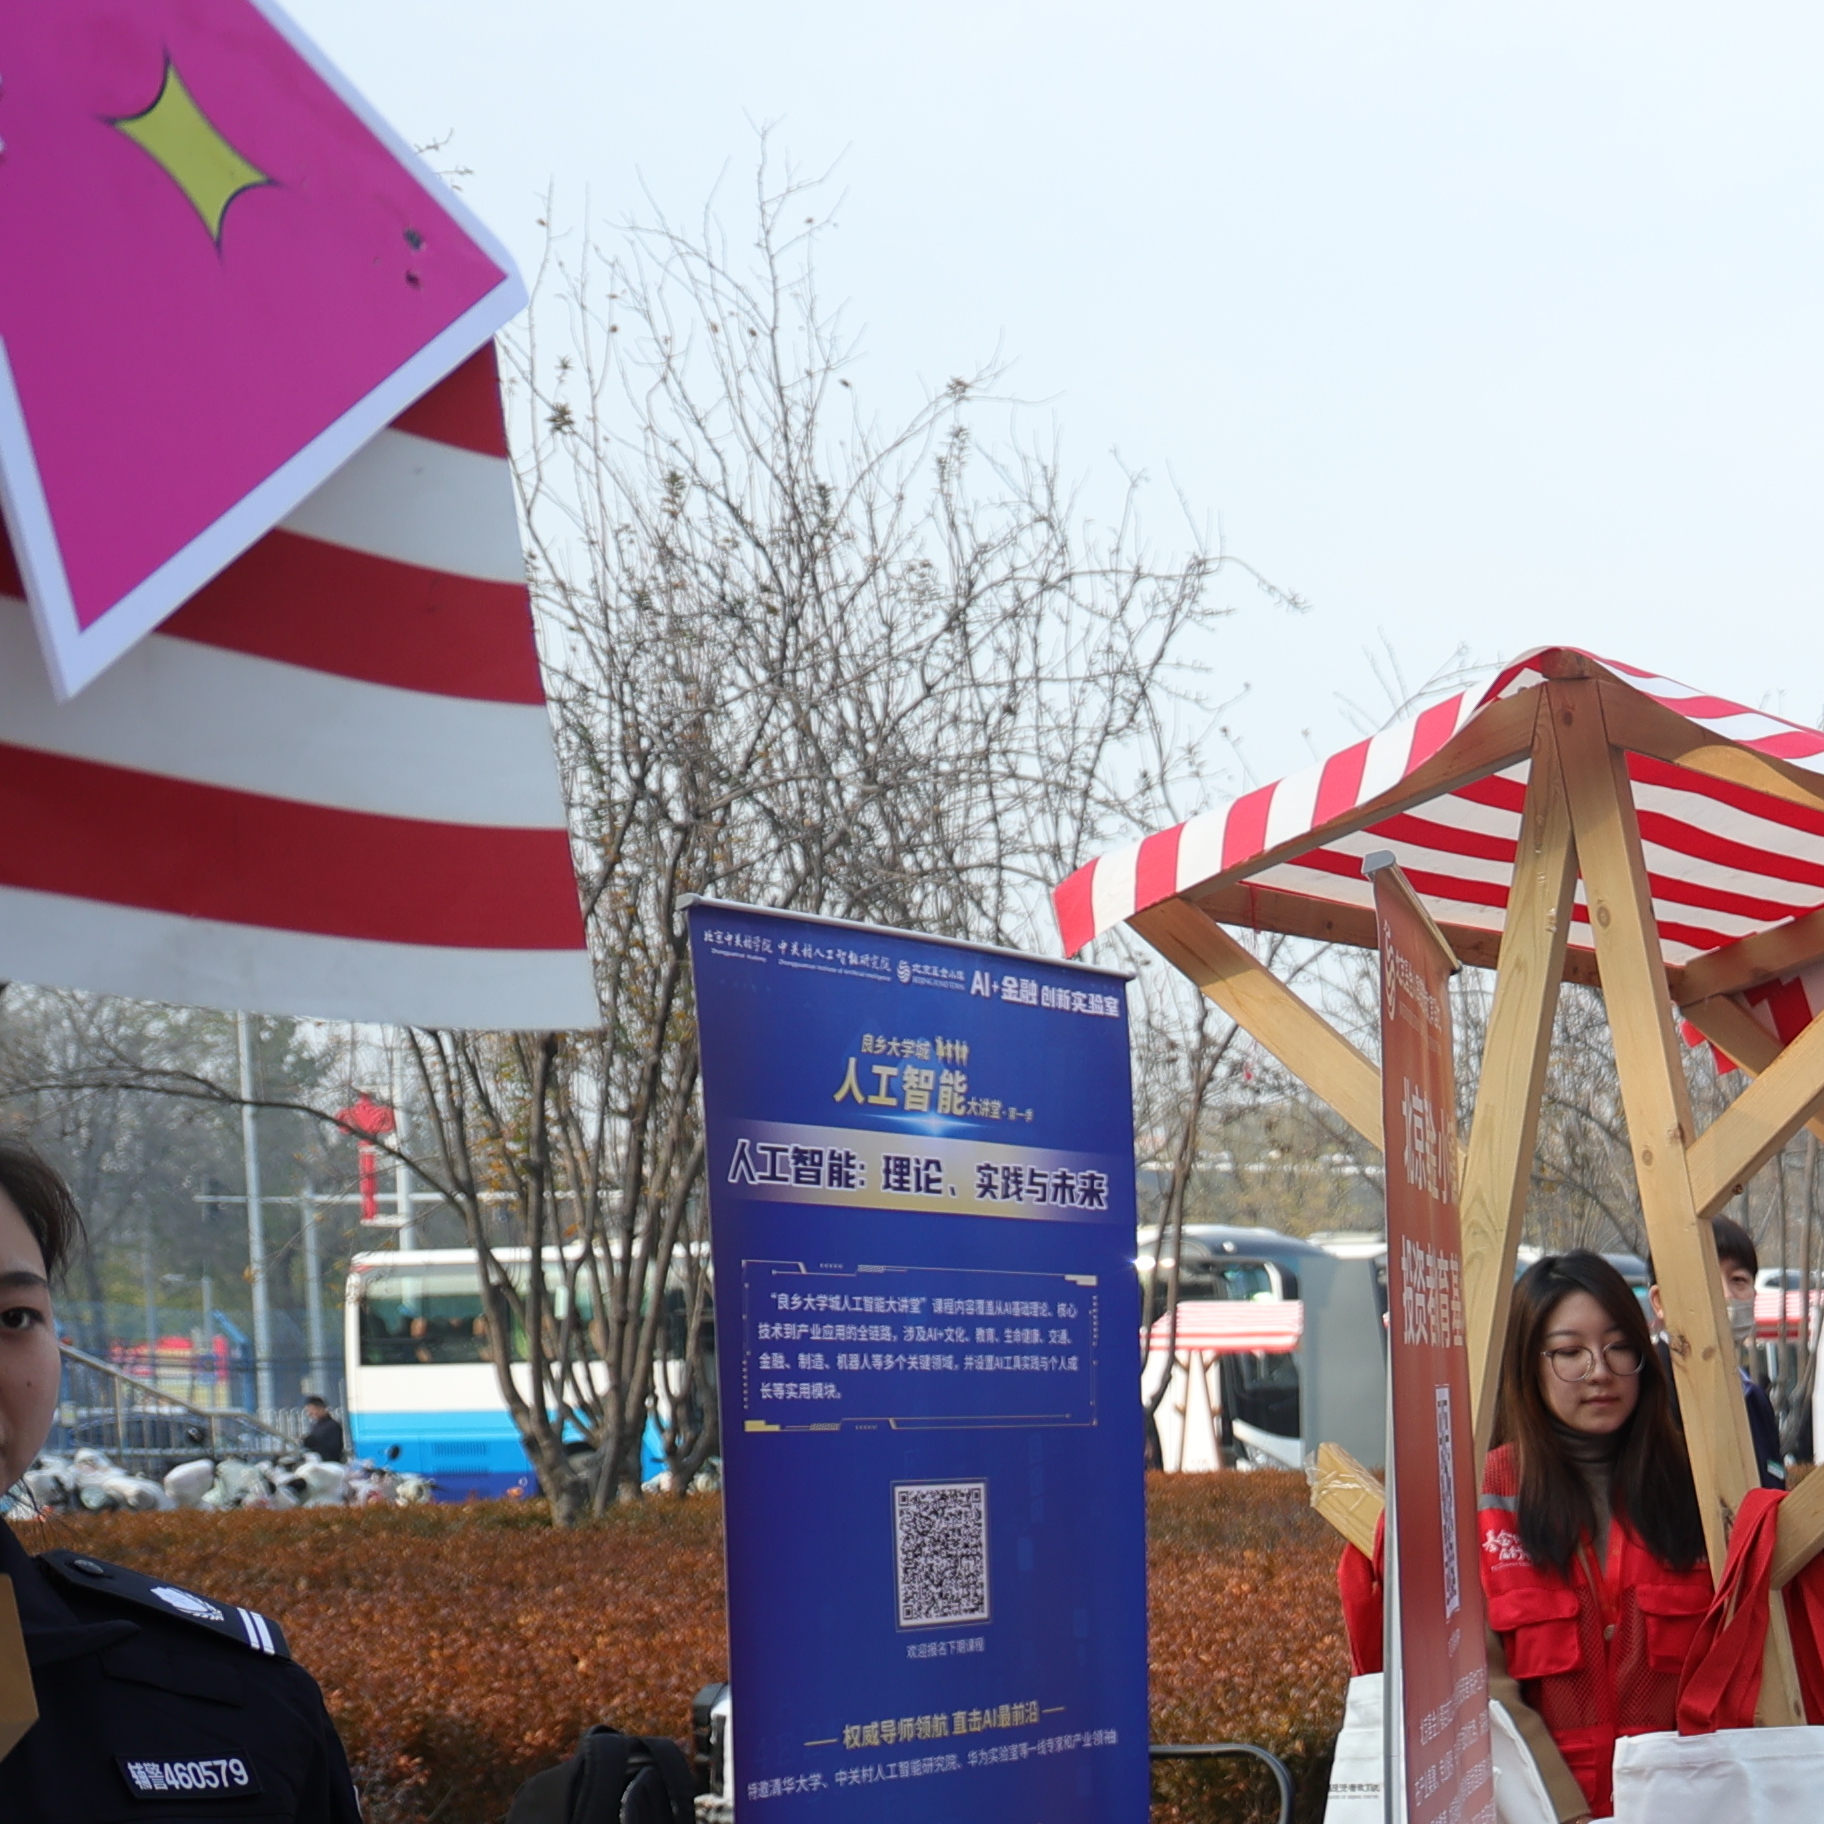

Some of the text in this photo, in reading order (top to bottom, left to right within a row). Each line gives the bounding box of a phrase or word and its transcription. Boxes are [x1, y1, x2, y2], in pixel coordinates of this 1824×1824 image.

[970, 970, 1037, 1006] AI+金融
[1040, 986, 1121, 1018] 创新实验室
[861, 1033, 930, 1061] 良乡大学城
[832, 1056, 967, 1114] 人工智能
[842, 1700, 1040, 1751] 权威导师领航 直击AI最前沿
[127, 1758, 249, 1791] 辅警460579
